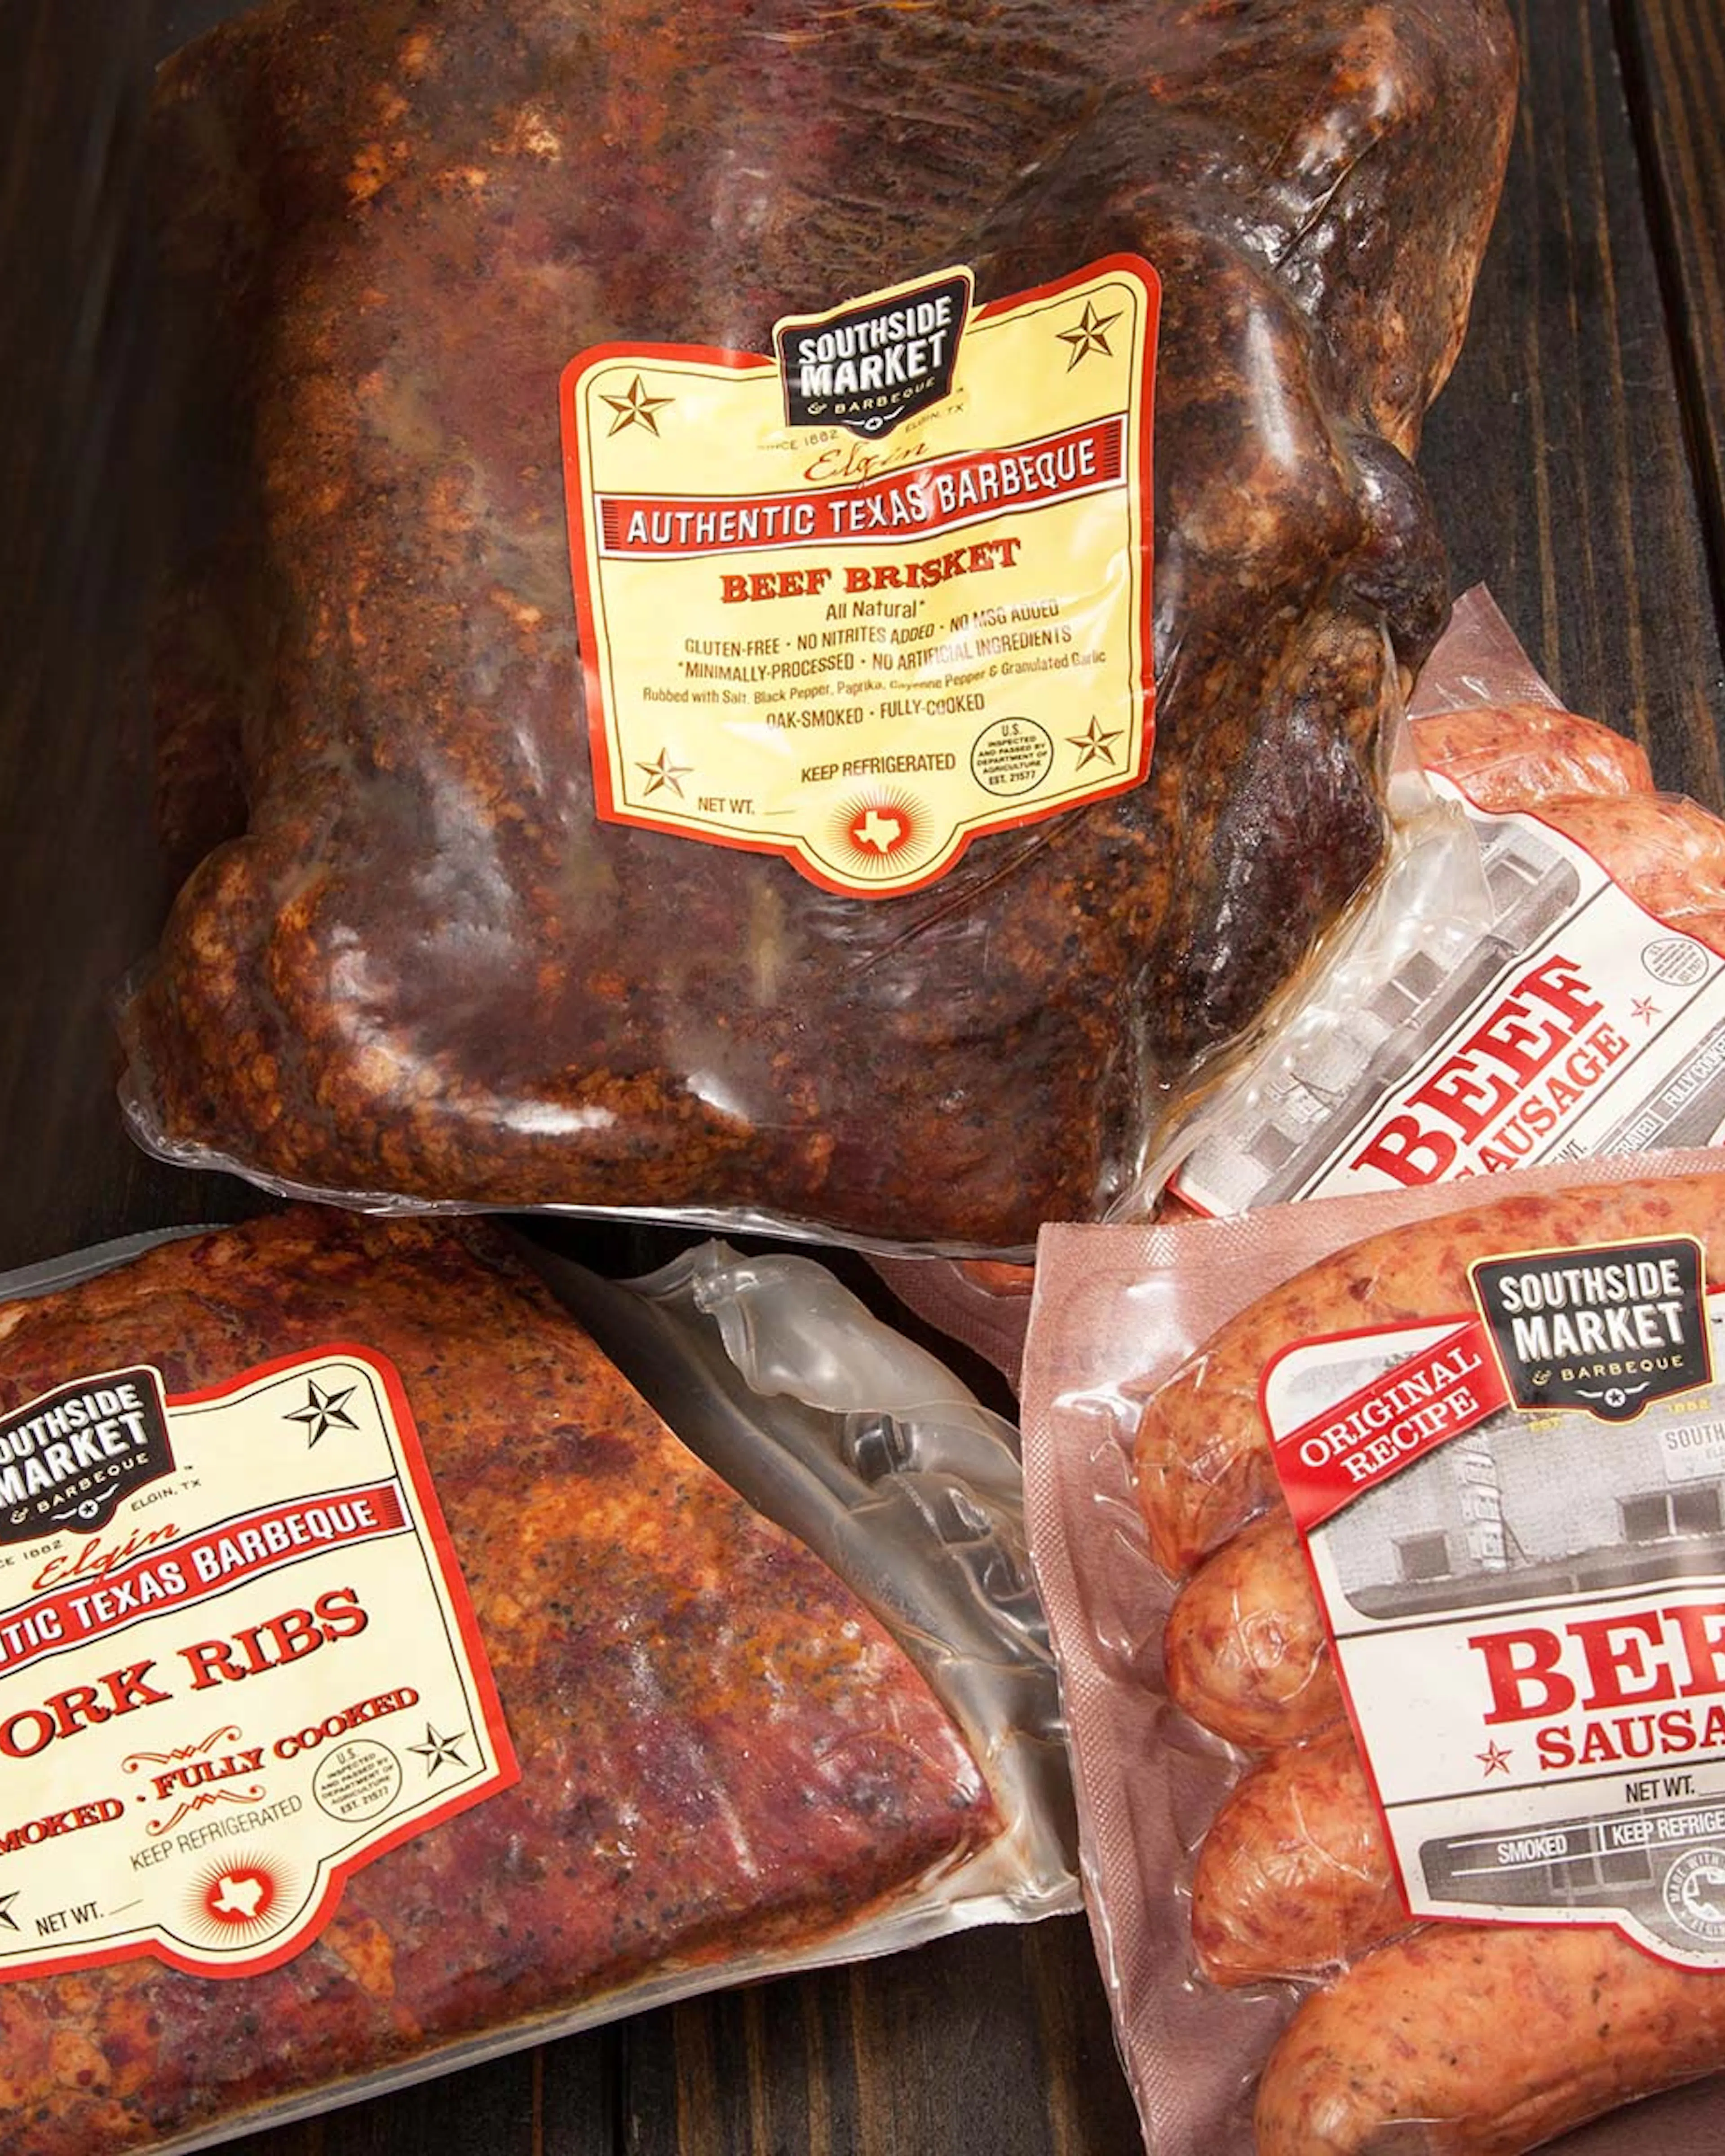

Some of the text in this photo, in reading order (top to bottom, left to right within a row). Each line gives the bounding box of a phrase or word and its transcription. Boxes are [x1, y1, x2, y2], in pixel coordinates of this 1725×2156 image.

[799, 296, 951, 364] SOUTHSIDE
[801, 330, 947, 398] MARKET
[807, 376, 935, 415] & BARBEQUE
[627, 438, 1096, 544] AUTHENTIC TEXAS BARBEQUE
[804, 441, 930, 489] Elgin
[720, 538, 1021, 603] BEEF BRISKET
[685, 599, 1059, 657] GLUTEN-FREE NO NITRITES ADDED NO MSG ADDED
[826, 603, 847, 621] All
[873, 653, 893, 671] NO
[898, 641, 973, 671] ARTIFICIAL
[975, 625, 1072, 656] INGREDIENTS
[643, 687, 688, 703] Rubbed
[692, 689, 719, 703] with
[754, 689, 786, 705] Black
[945, 669, 986, 689] Pepper
[989, 666, 998, 677] &
[1001, 654, 1069, 676] Granulated
[766, 693, 985, 730] OAK-SMOKED FULLY-COOKED
[801, 752, 956, 783] KEEP REFRIGERATED
[698, 796, 755, 815] NET WT.
[1350, 954, 1604, 1188] BEEF
[1498, 1259, 1684, 1314] SOUTHSIDE
[1511, 1301, 1685, 1363] MARKET
[1531, 1355, 1685, 1386] & BARBEQUE
[1300, 1346, 1482, 1468] ORIGINAL
[1340, 1386, 1479, 1483] RECIPE
[0, 1410, 148, 1509] MARKET
[9, 1452, 150, 1525] & BARBEQUE
[181, 1478, 202, 1490] TX
[32, 1523, 180, 1590] Elgin
[67, 1561, 187, 1629] TEXAS
[191, 1499, 379, 1584] BARBEQUE
[177, 1587, 369, 1691] RIBS
[150, 1747, 265, 1800] FULLY
[273, 1686, 420, 1759] COOKED
[1625, 1775, 1695, 1803] NET WT.
[129, 1794, 303, 1872] KEEP REFRIGERATED
[1497, 1834, 1568, 1864] SMOKED
[1613, 1820, 1654, 1847] KEEP
[35, 1900, 105, 1937] NET WT.
